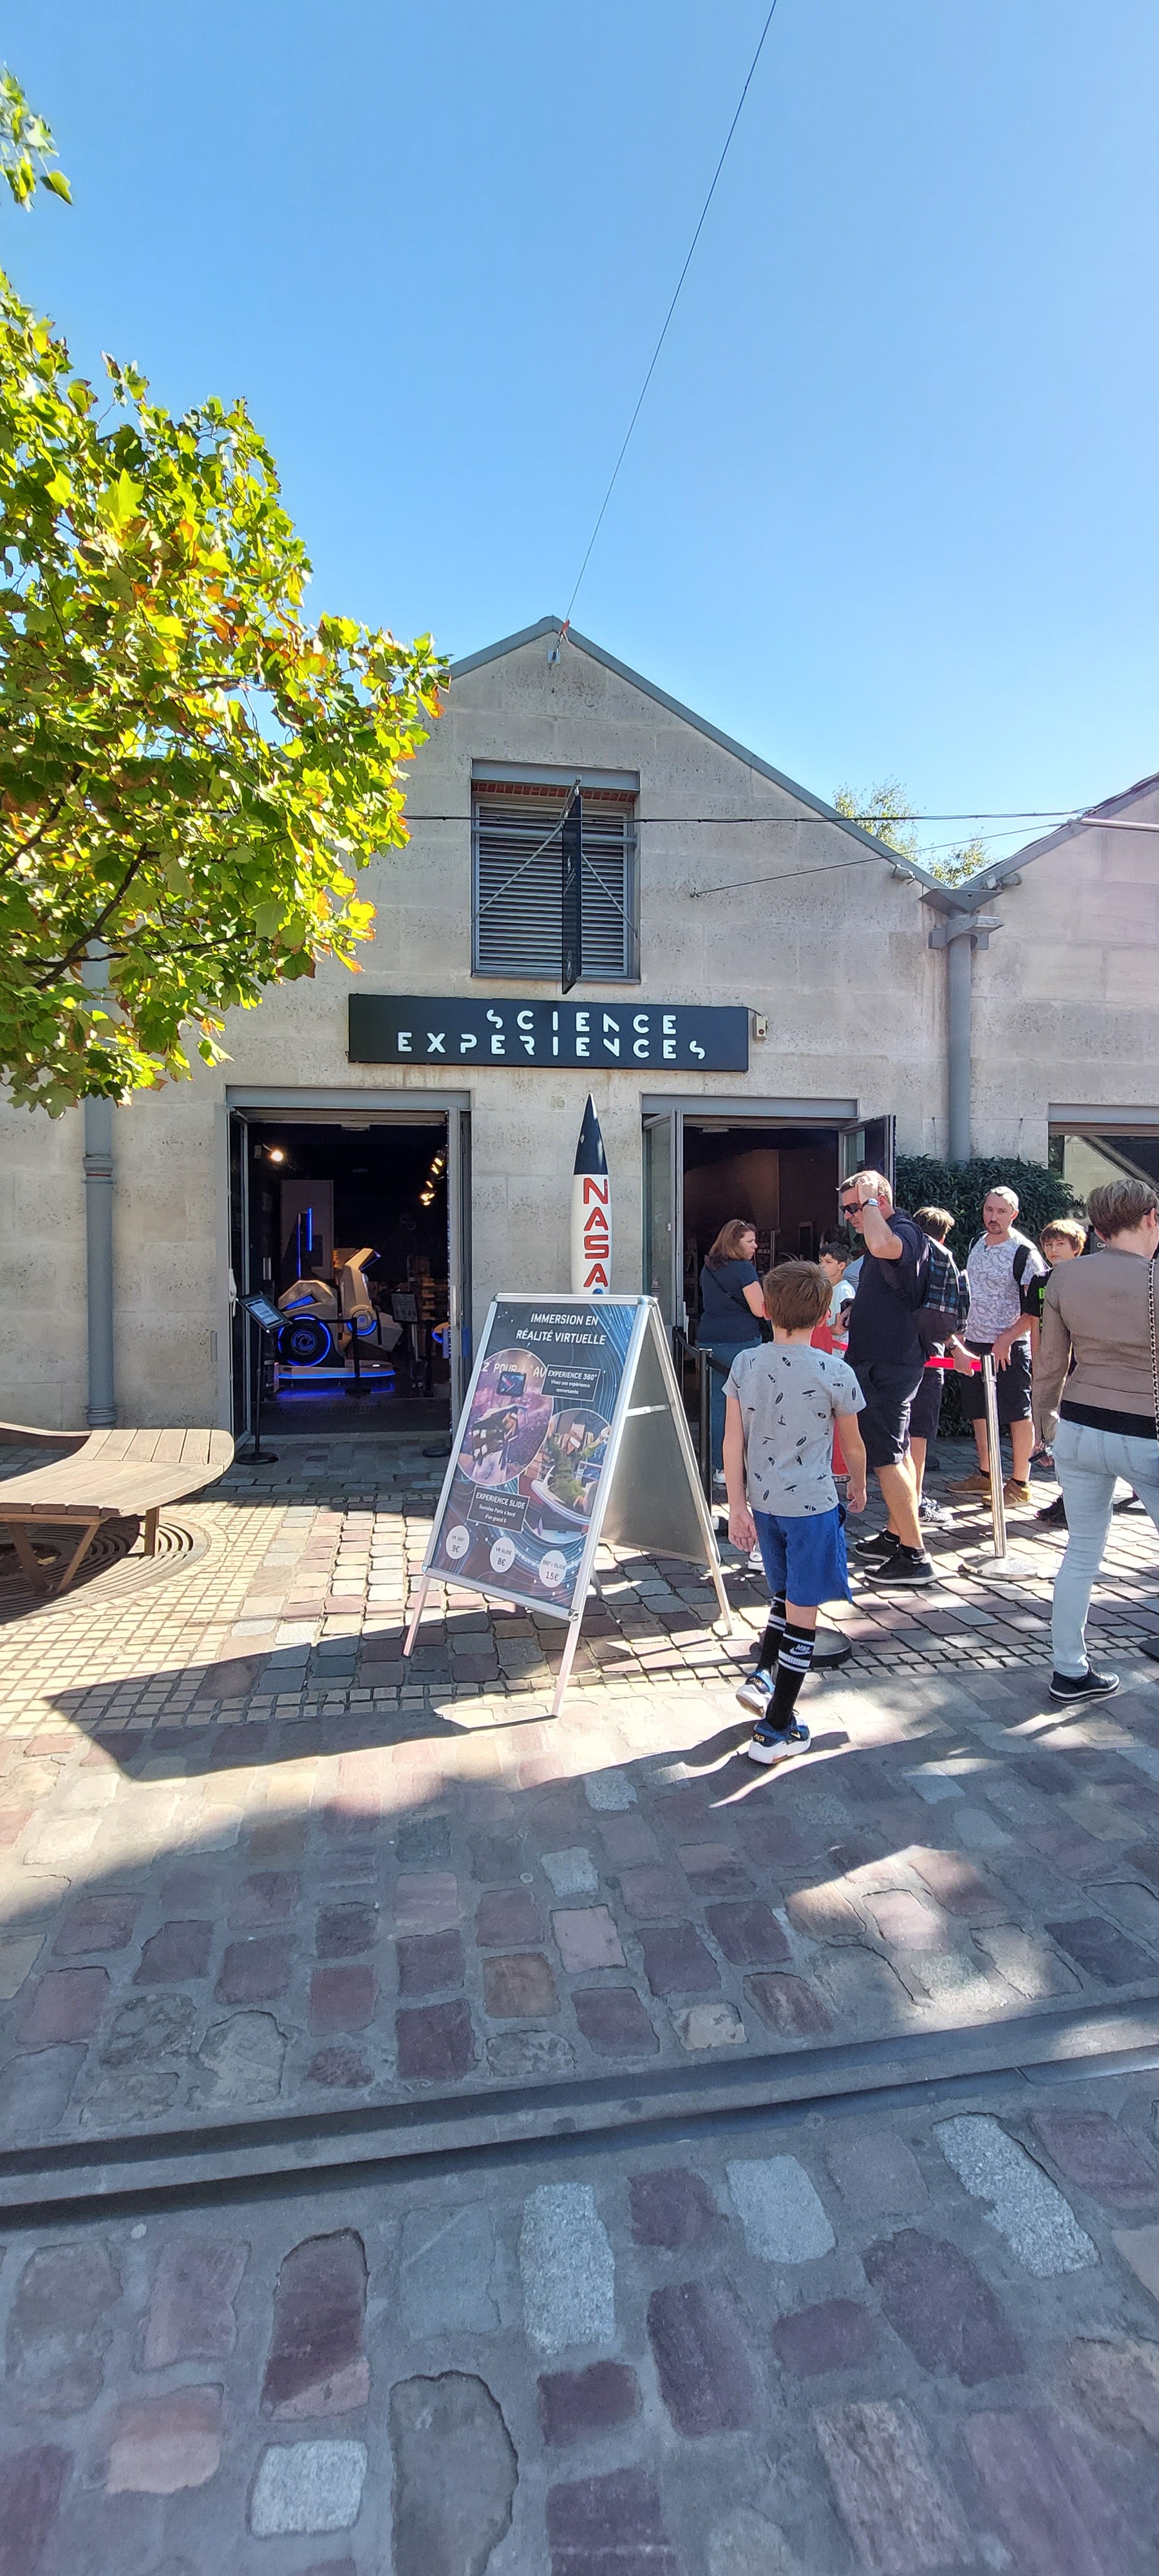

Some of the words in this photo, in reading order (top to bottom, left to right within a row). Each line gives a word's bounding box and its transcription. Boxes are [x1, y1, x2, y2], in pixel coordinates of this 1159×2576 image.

[487, 1009, 677, 1034] SCIENCE
[397, 1032, 706, 1060] EXPERIENCES
[583, 1177, 609, 1287] NASA
[531, 1312, 583, 1326] IMMERSION
[585, 1315, 598, 1327] EN
[516, 1328, 553, 1342] RÉALITÉ
[554, 1331, 607, 1345] VIRTUELLE
[547, 1370, 583, 1379] EXPERIENCE
[476, 1492, 509, 1506] EXPERIENCE
[509, 1499, 526, 1510] SLIDE
[451, 1544, 460, 1553] 9€
[497, 1557, 506, 1567] 8€
[545, 1571, 560, 1582] 15€
[753, 1734, 765, 1743] AIR
